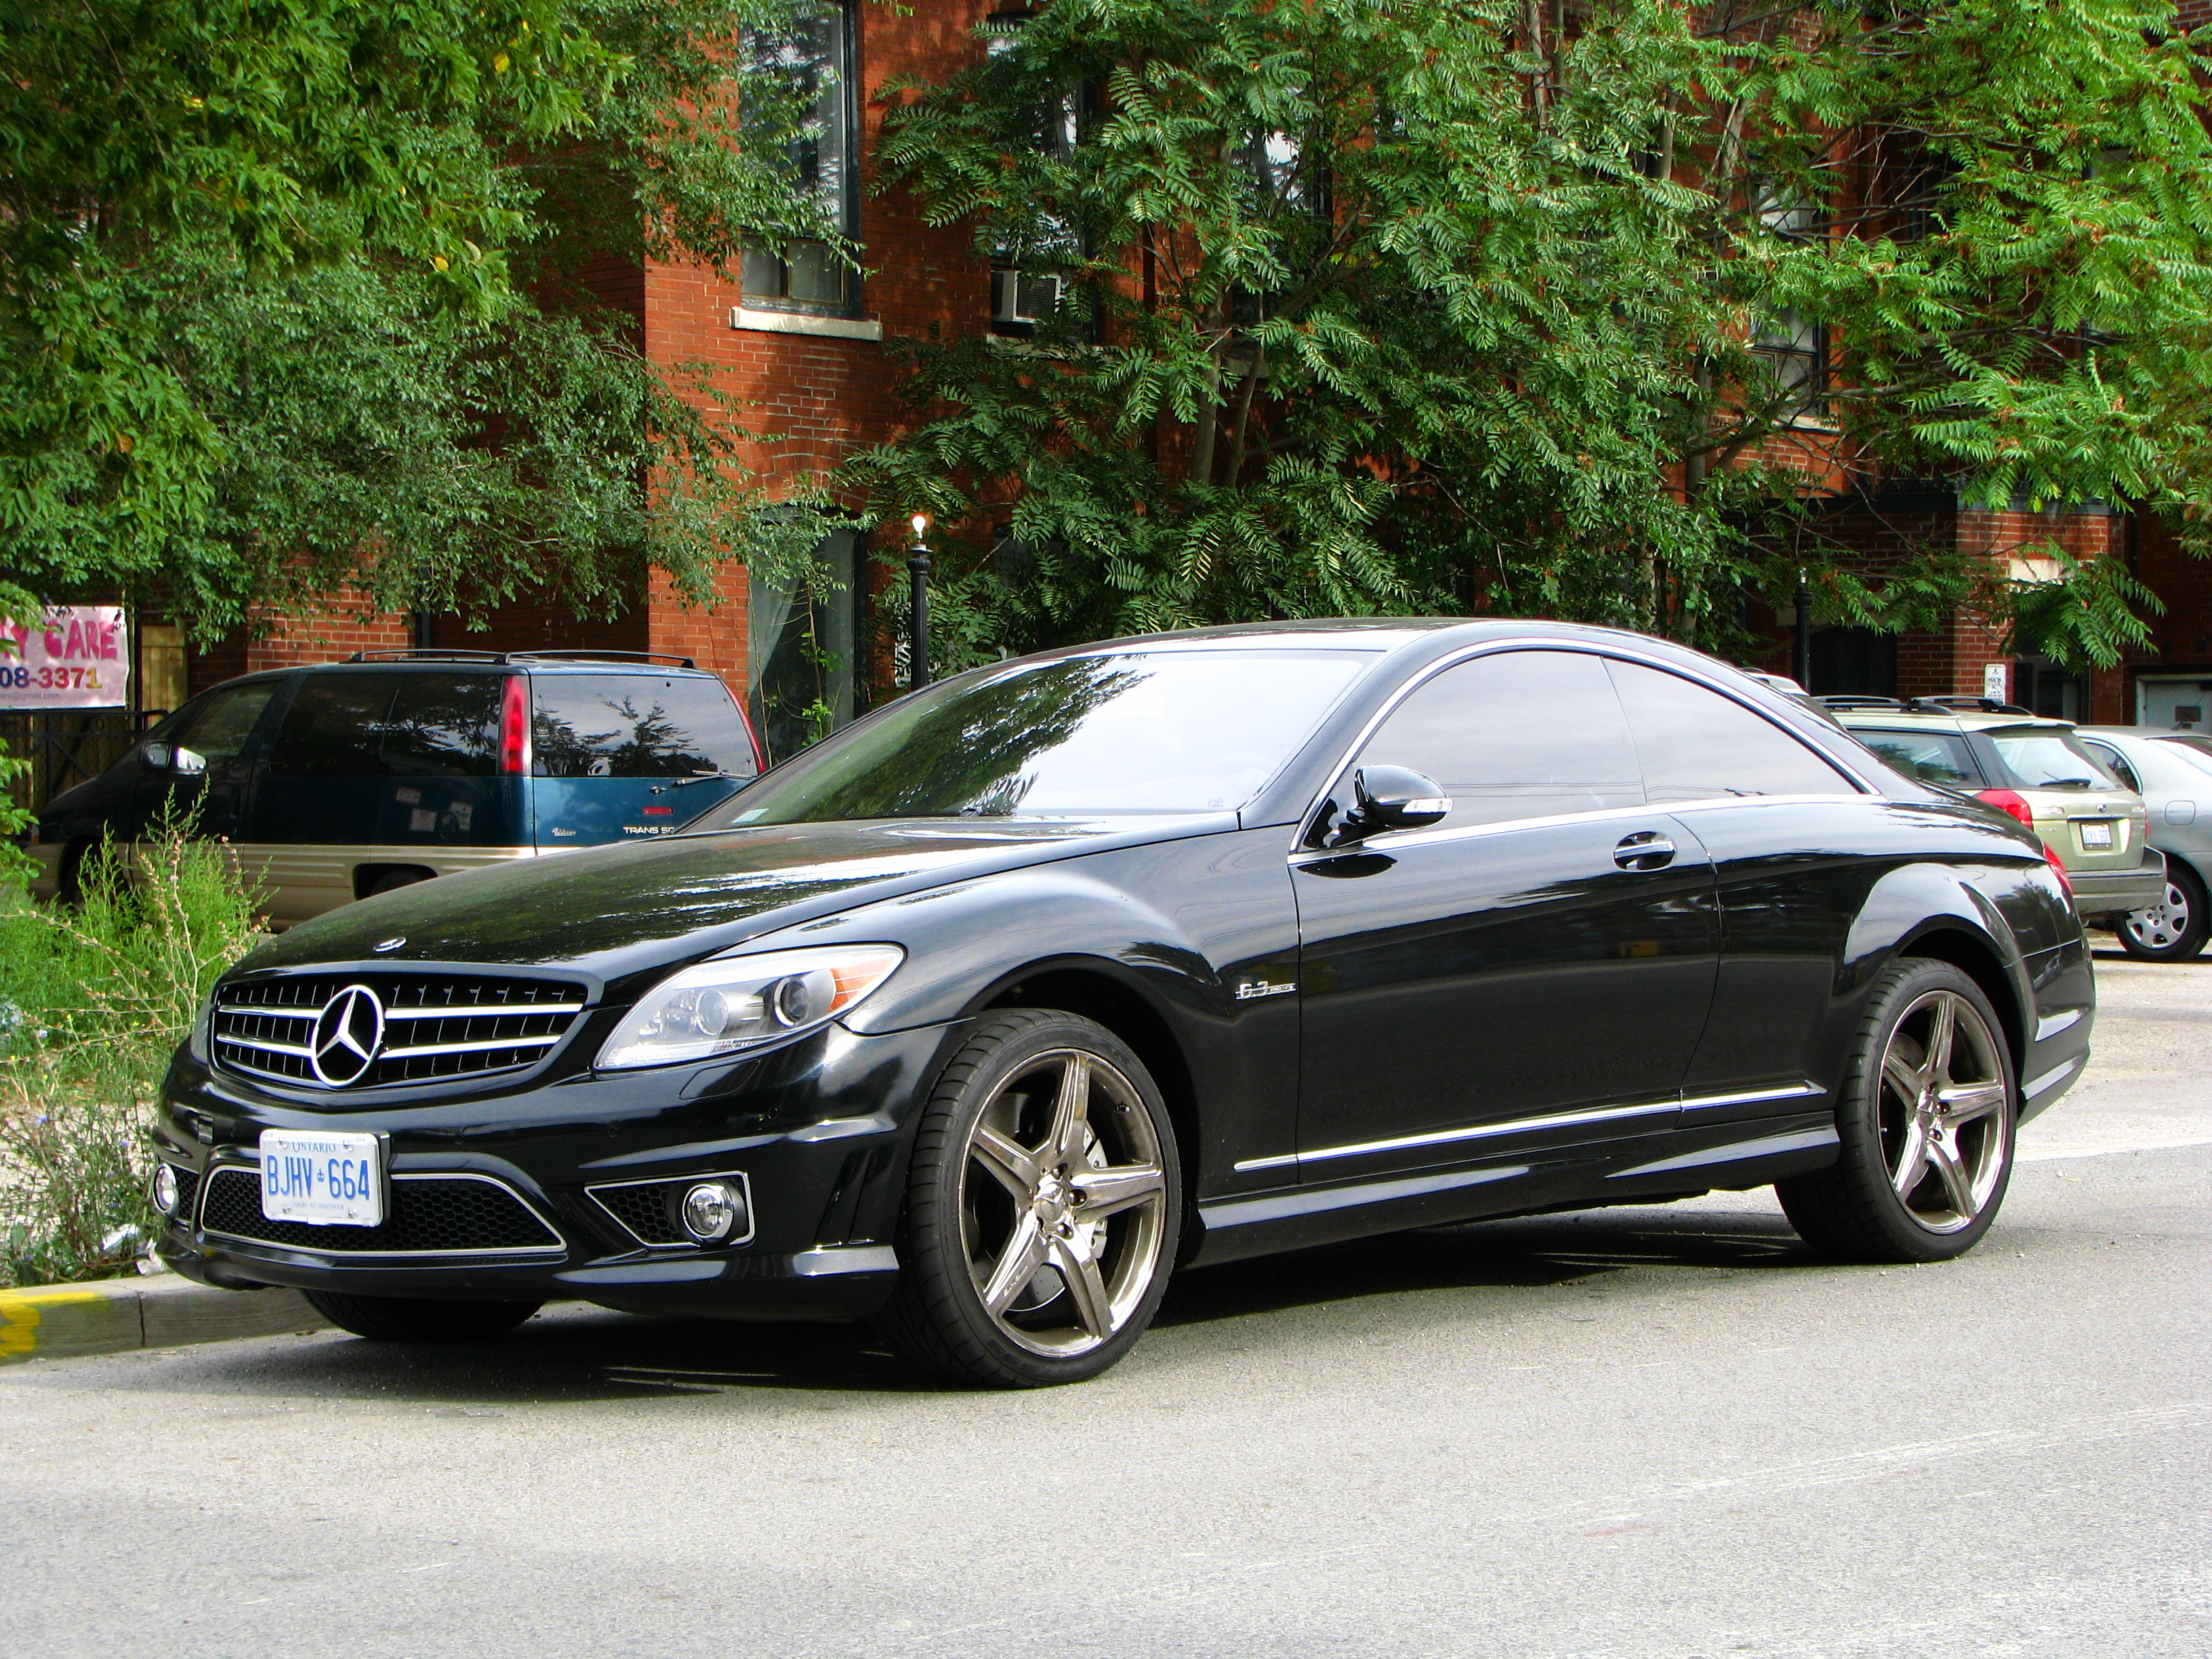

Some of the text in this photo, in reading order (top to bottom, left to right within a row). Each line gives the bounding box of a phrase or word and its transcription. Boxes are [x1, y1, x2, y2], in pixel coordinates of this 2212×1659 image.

[44, 619, 117, 660] CARE
[0, 665, 102, 689] 08-3371
[623, 826, 659, 834] TRANS
[291, 1141, 337, 1153] ONTARIO
[266, 1154, 371, 1201] BJHV 664
